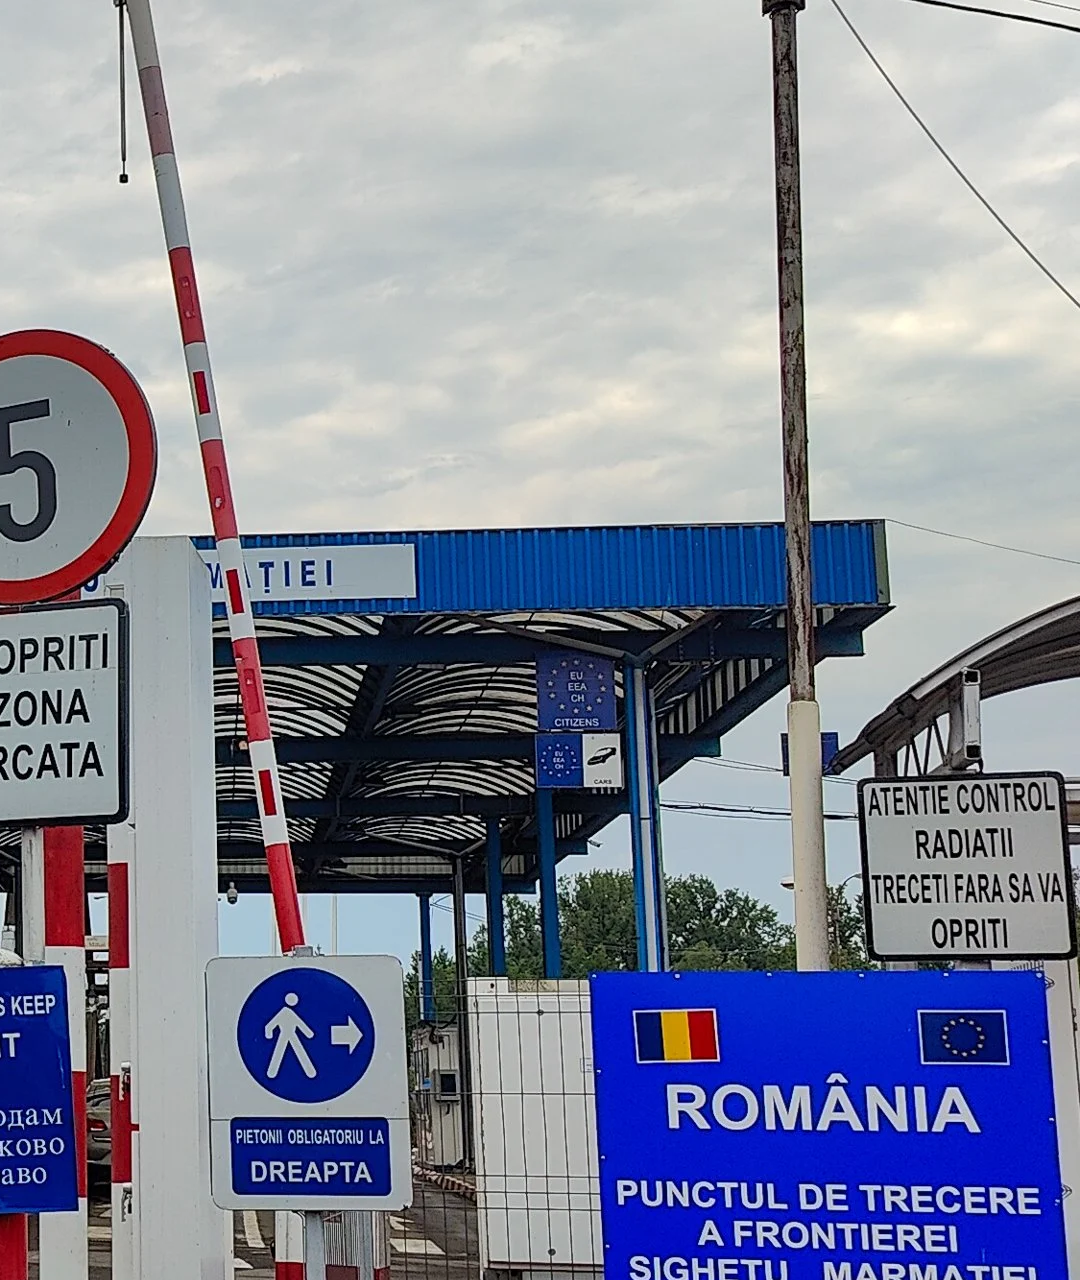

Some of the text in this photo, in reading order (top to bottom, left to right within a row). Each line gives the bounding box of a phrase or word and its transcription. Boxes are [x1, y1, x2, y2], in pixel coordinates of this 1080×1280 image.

[567, 682, 587, 691] EEA
[569, 671, 583, 680] EU
[570, 694, 585, 703] CH
[554, 718, 600, 727] CITIZENS
[869, 781, 1056, 816] ATENTIE CONTROL
[915, 827, 1014, 859] RADIATII
[871, 872, 1064, 904] TRECETI FARA SA VA
[931, 918, 1008, 949] OPRITI
[10, 994, 56, 1016] KEEP
[666, 1073, 981, 1134] ROMÂNIA
[235, 1129, 385, 1145] PIETONII OBLIGATORIU LA
[250, 1160, 373, 1183] DREAPTA
[616, 1180, 1042, 1215] PUNCTUL DE TRECERE
[697, 1220, 959, 1252] A FRONTIEREI
